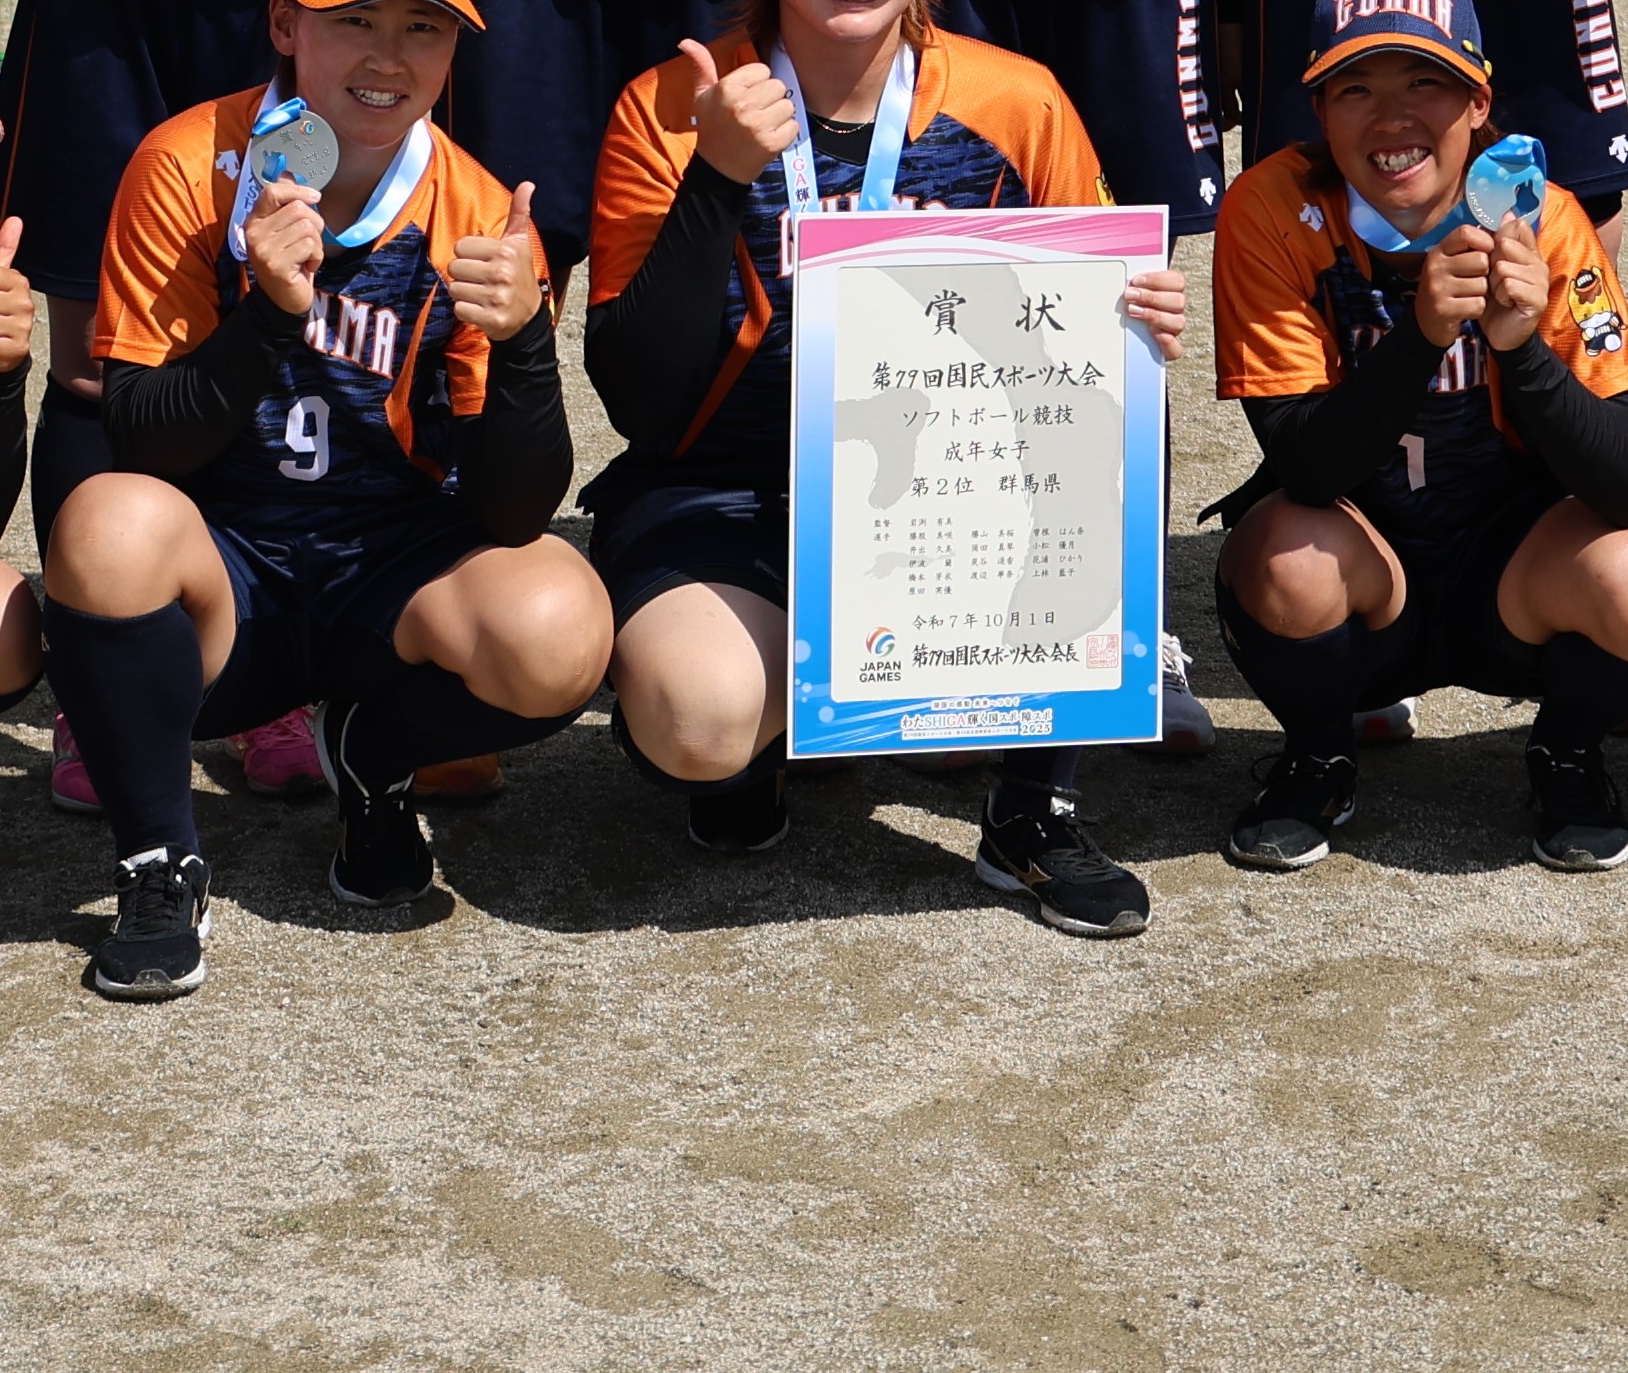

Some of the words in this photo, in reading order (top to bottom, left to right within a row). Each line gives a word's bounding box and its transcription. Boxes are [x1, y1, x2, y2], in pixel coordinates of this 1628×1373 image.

[924, 288, 1066, 337] 賞状
[302, 291, 401, 379] NMA
[872, 361, 1105, 390] 第79回国民スポーツ大会
[902, 405, 1075, 428] ソフトボール競技
[278, 395, 331, 482] 9
[943, 440, 1030, 463] 成年女子
[1398, 433, 1427, 492] 1
[910, 476, 975, 497] 第2位
[998, 472, 1062, 495] 群馬県
[859, 672, 901, 683] GAMES
[860, 660, 901, 672] JAPAN
[1022, 724, 1050, 734] 2025
